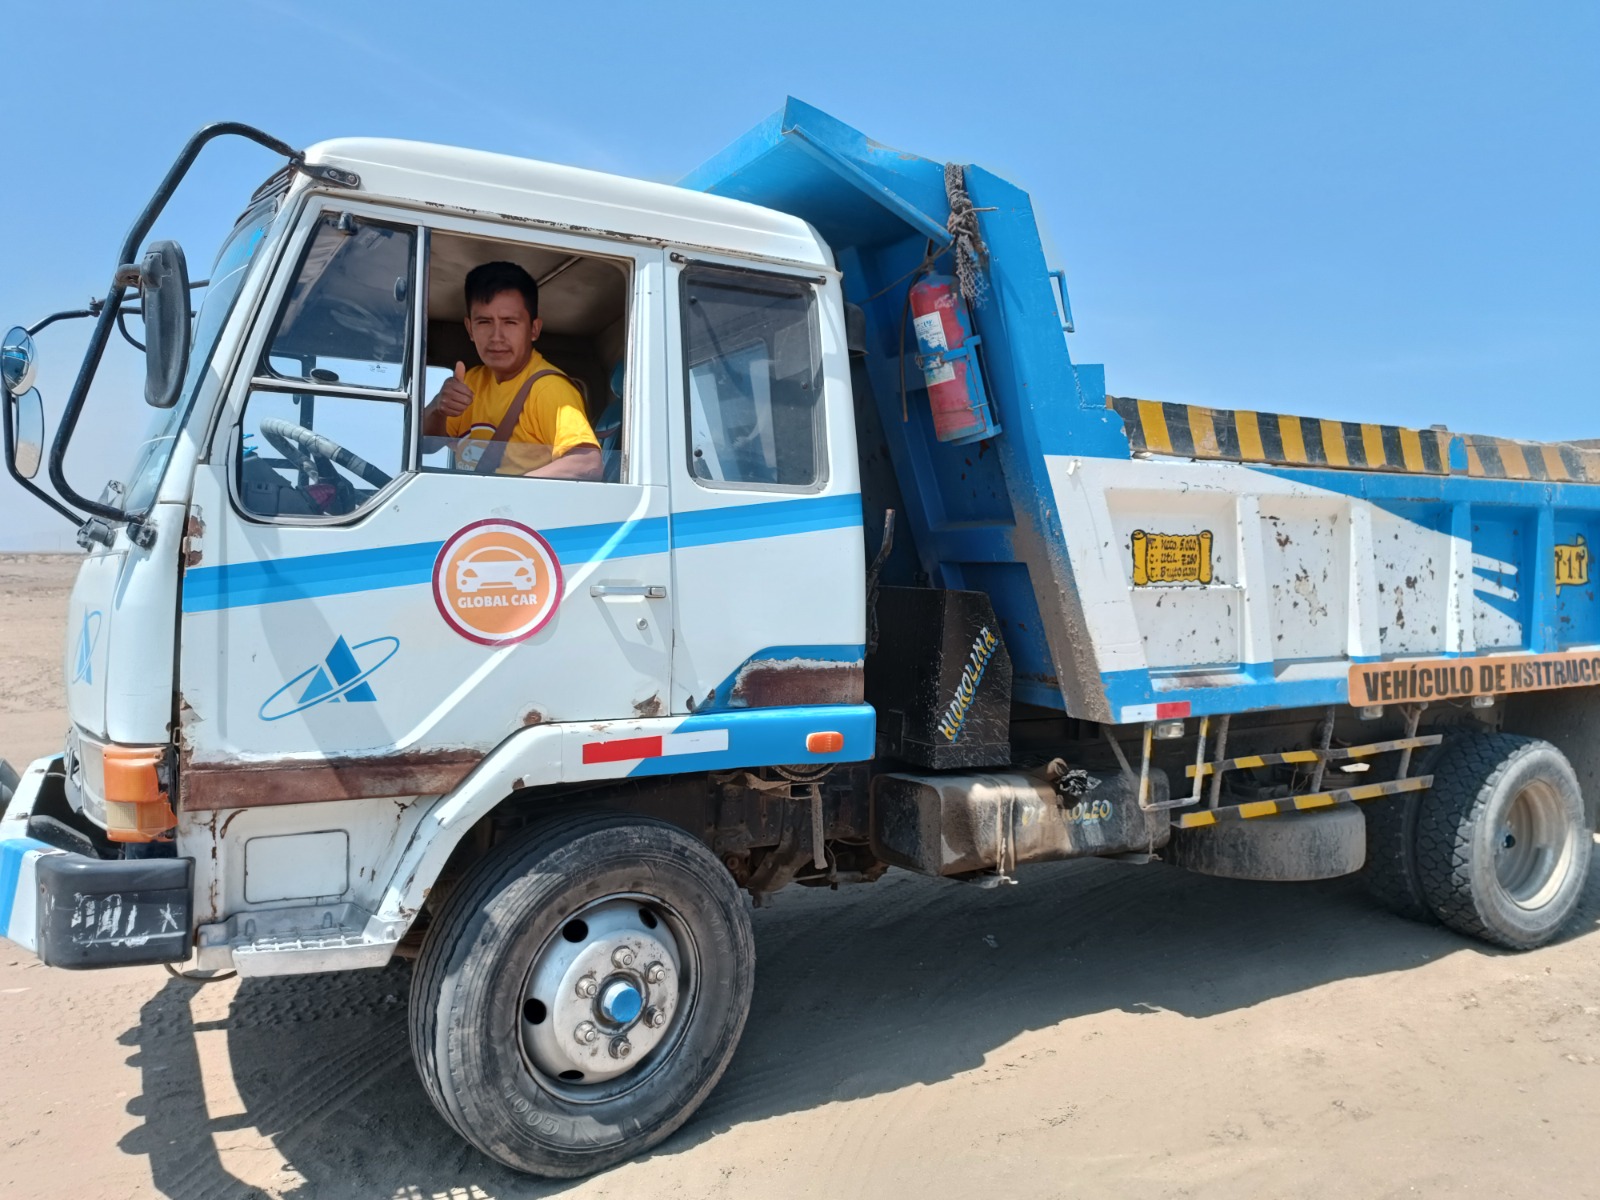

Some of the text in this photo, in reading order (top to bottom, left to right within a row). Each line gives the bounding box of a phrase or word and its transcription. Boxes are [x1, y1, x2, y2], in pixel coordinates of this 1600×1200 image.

[457, 593, 538, 609] GLOBAL CAR
[1363, 663, 1474, 702] VEHÍCULO
[1479, 664, 1506, 693] DE
